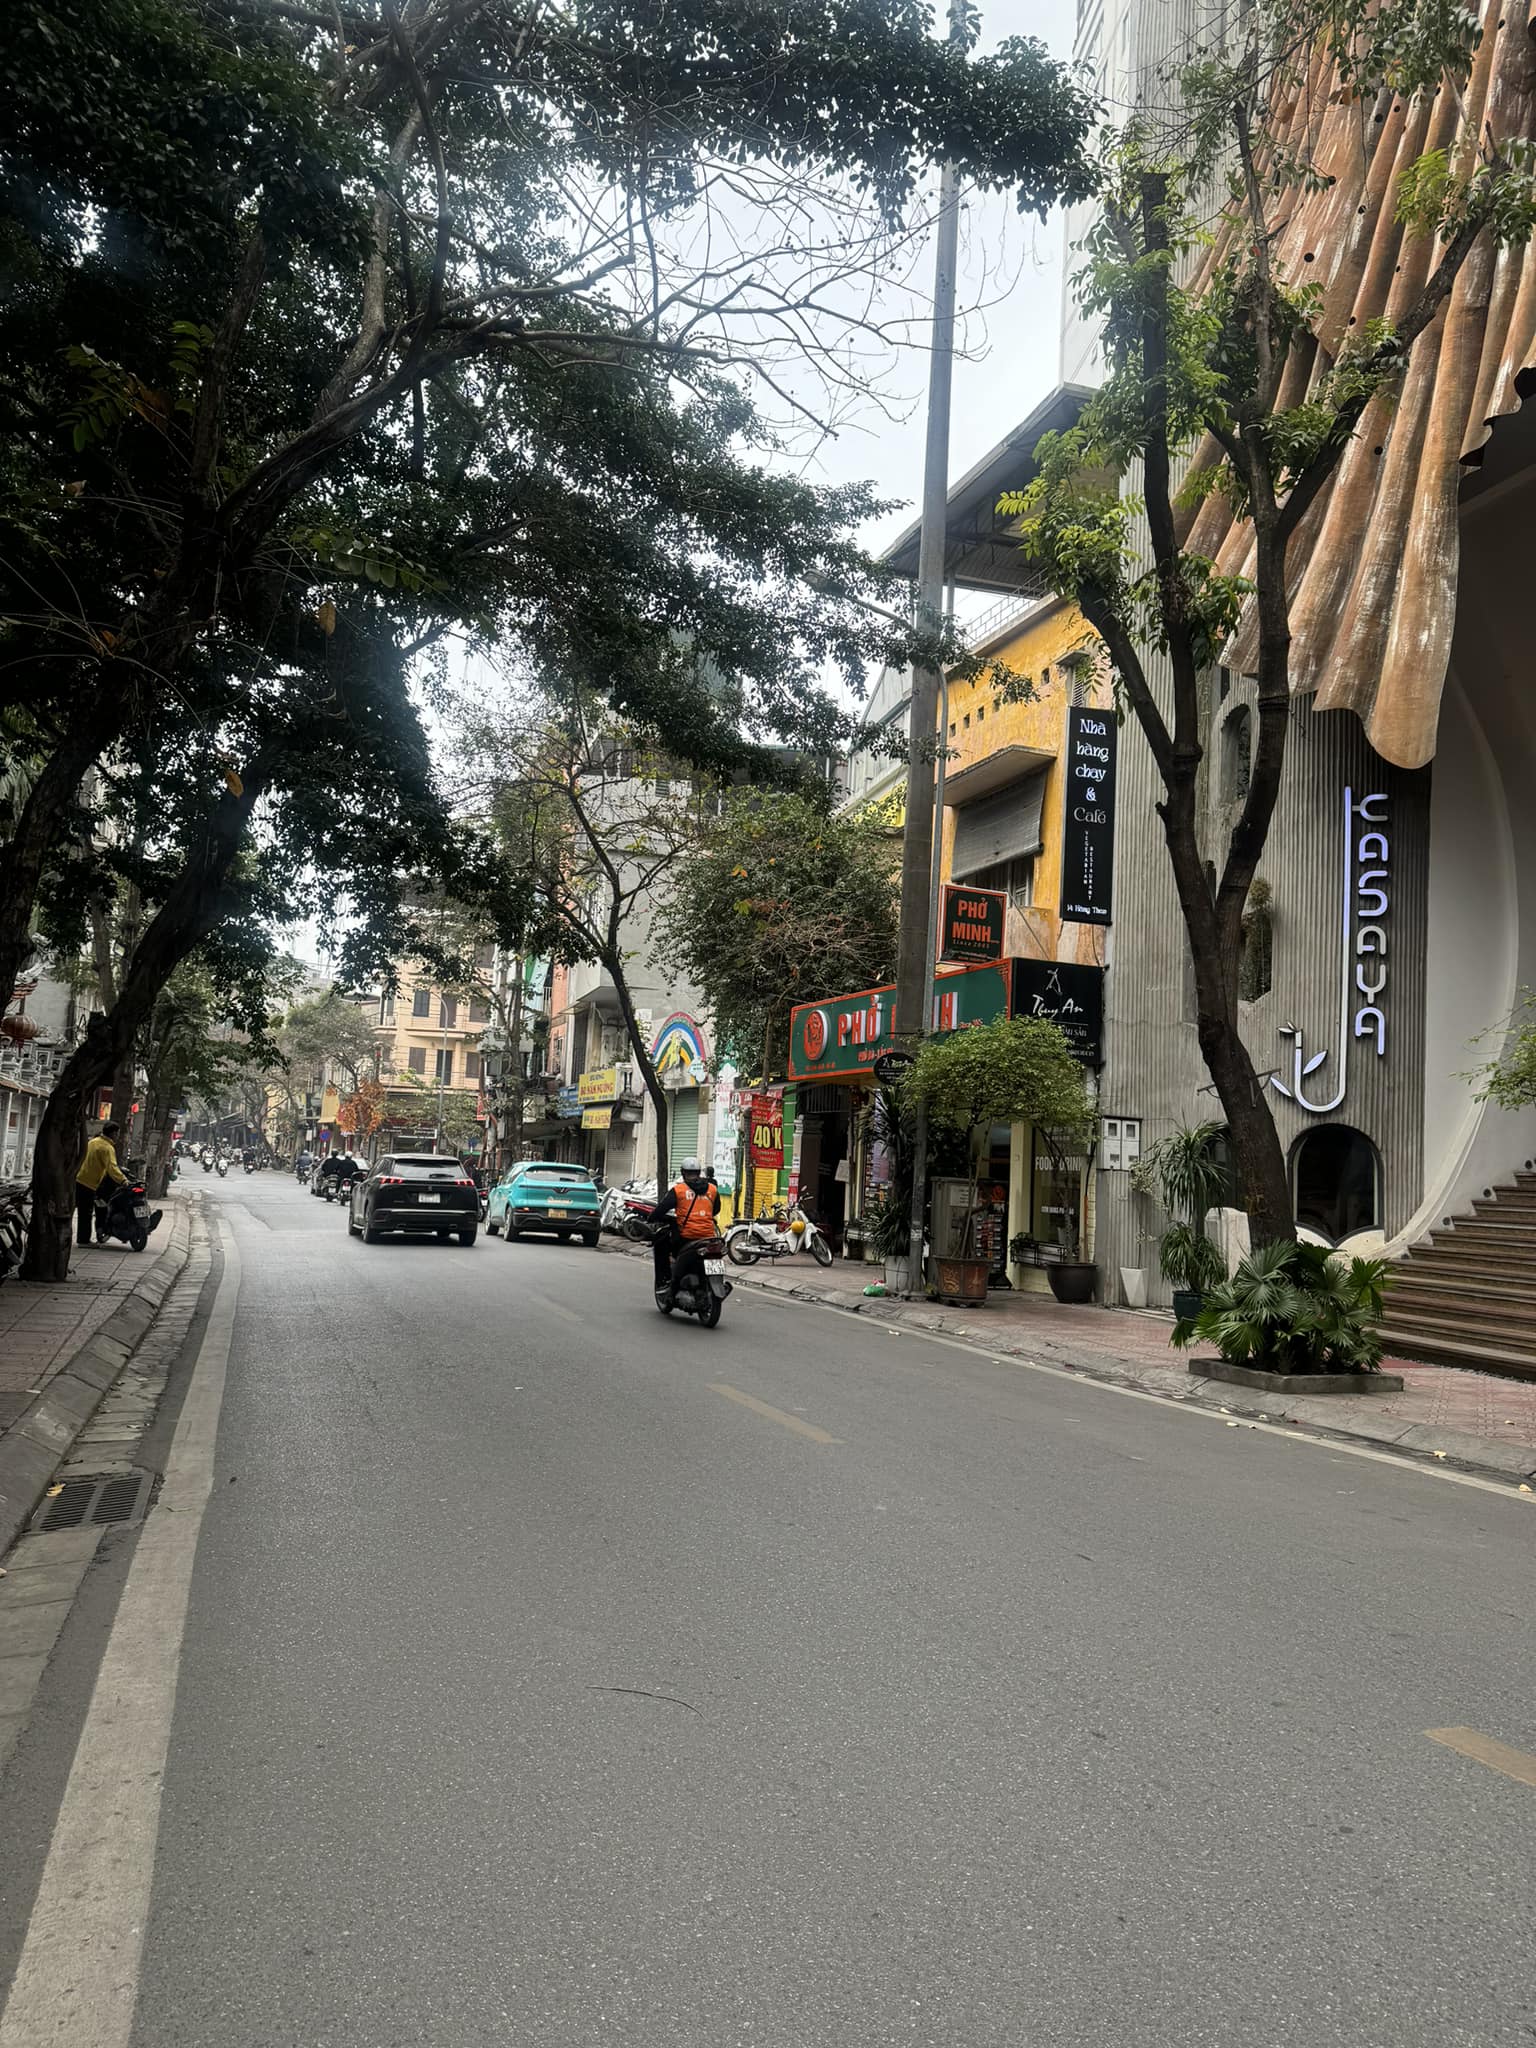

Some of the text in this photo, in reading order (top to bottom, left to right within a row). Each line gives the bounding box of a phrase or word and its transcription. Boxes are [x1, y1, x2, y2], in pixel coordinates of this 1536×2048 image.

[1080, 719, 1106, 736] Nhà
[1076, 741, 1109, 762] hàng
[1075, 763, 1106, 782] chay
[1085, 786, 1096, 801] &
[1074, 806, 1106, 824] Café
[957, 897, 988, 919] PHỞ
[952, 921, 991, 942] MINH
[1062, 998, 1084, 1014] An
[838, 995, 882, 1046] PHỞ
